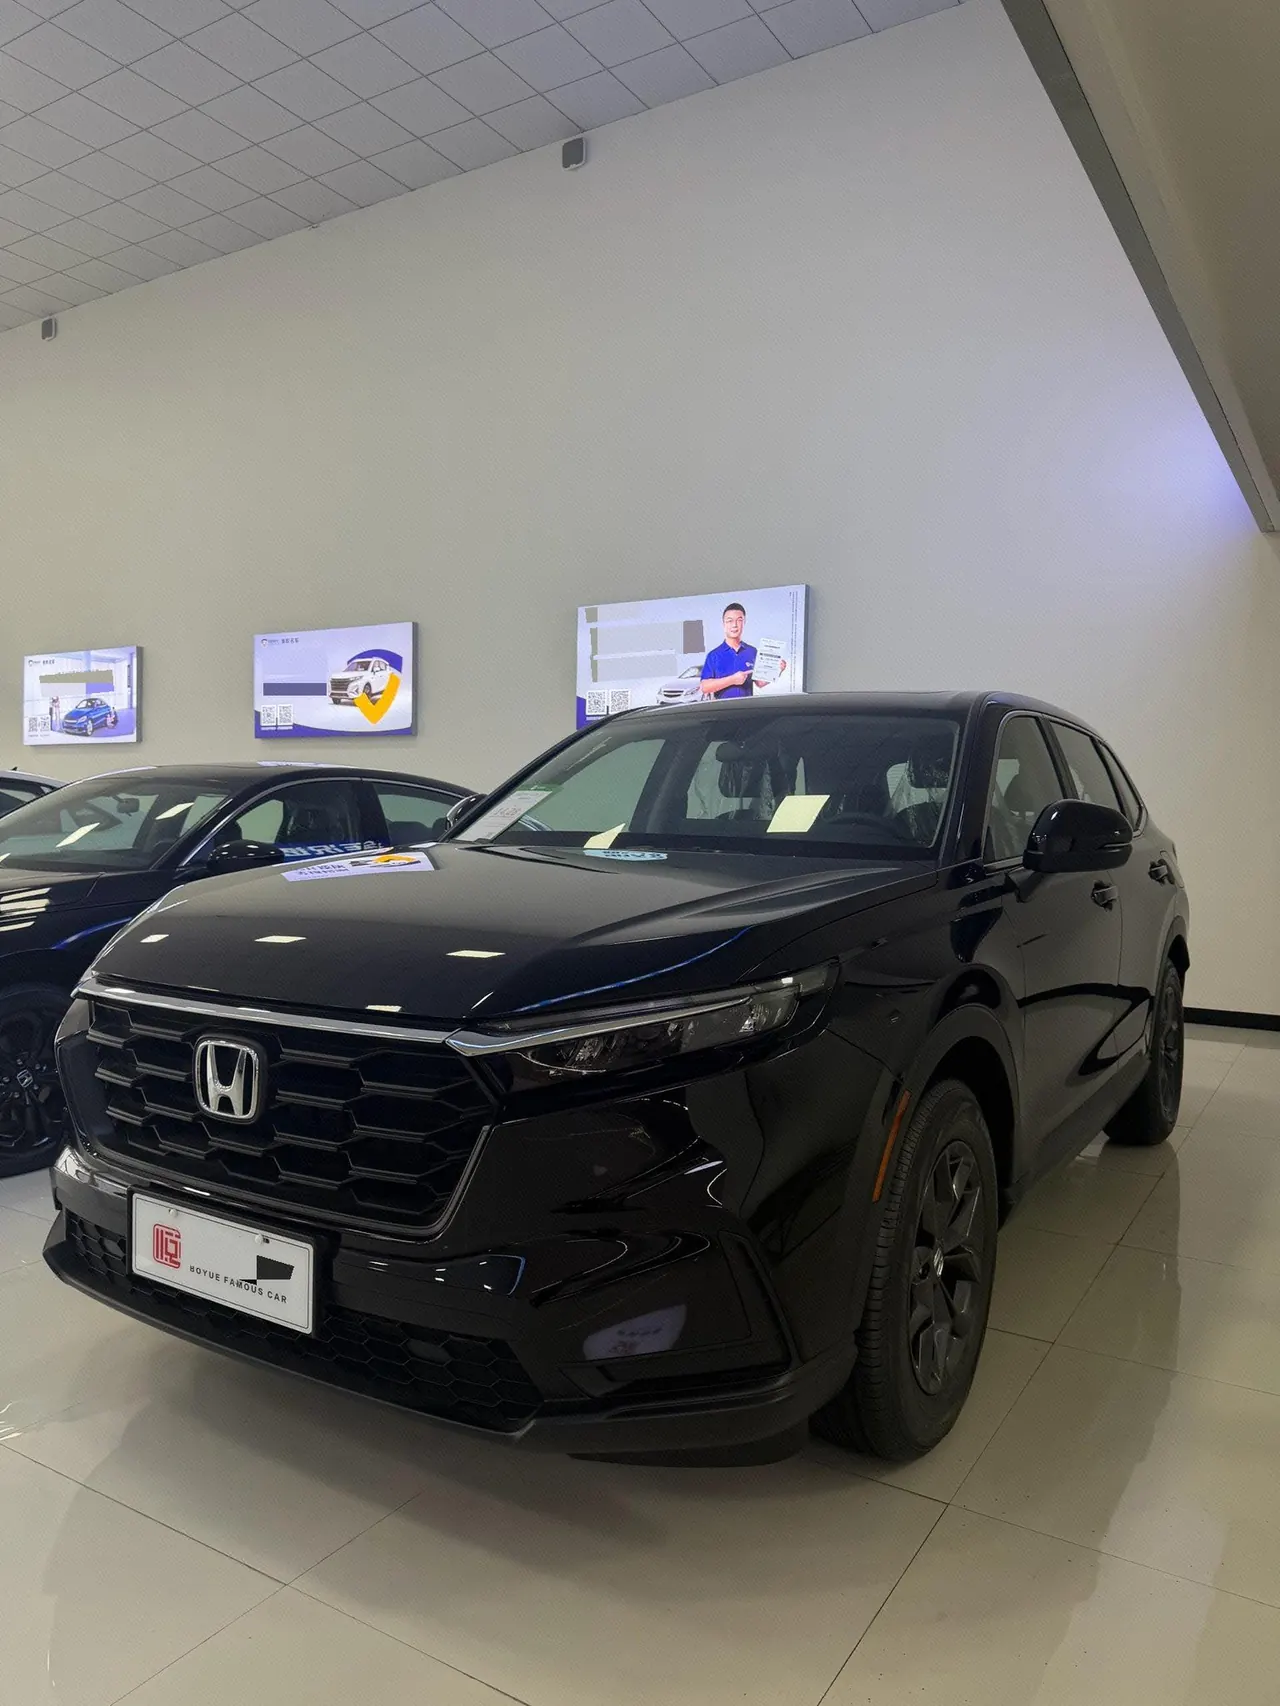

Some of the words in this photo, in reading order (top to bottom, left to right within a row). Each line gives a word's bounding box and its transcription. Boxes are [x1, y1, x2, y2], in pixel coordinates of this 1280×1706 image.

[190, 1265, 221, 1282] BOYUE
[223, 1276, 264, 1296] FAMOUS
[267, 1290, 287, 1304] CAR
